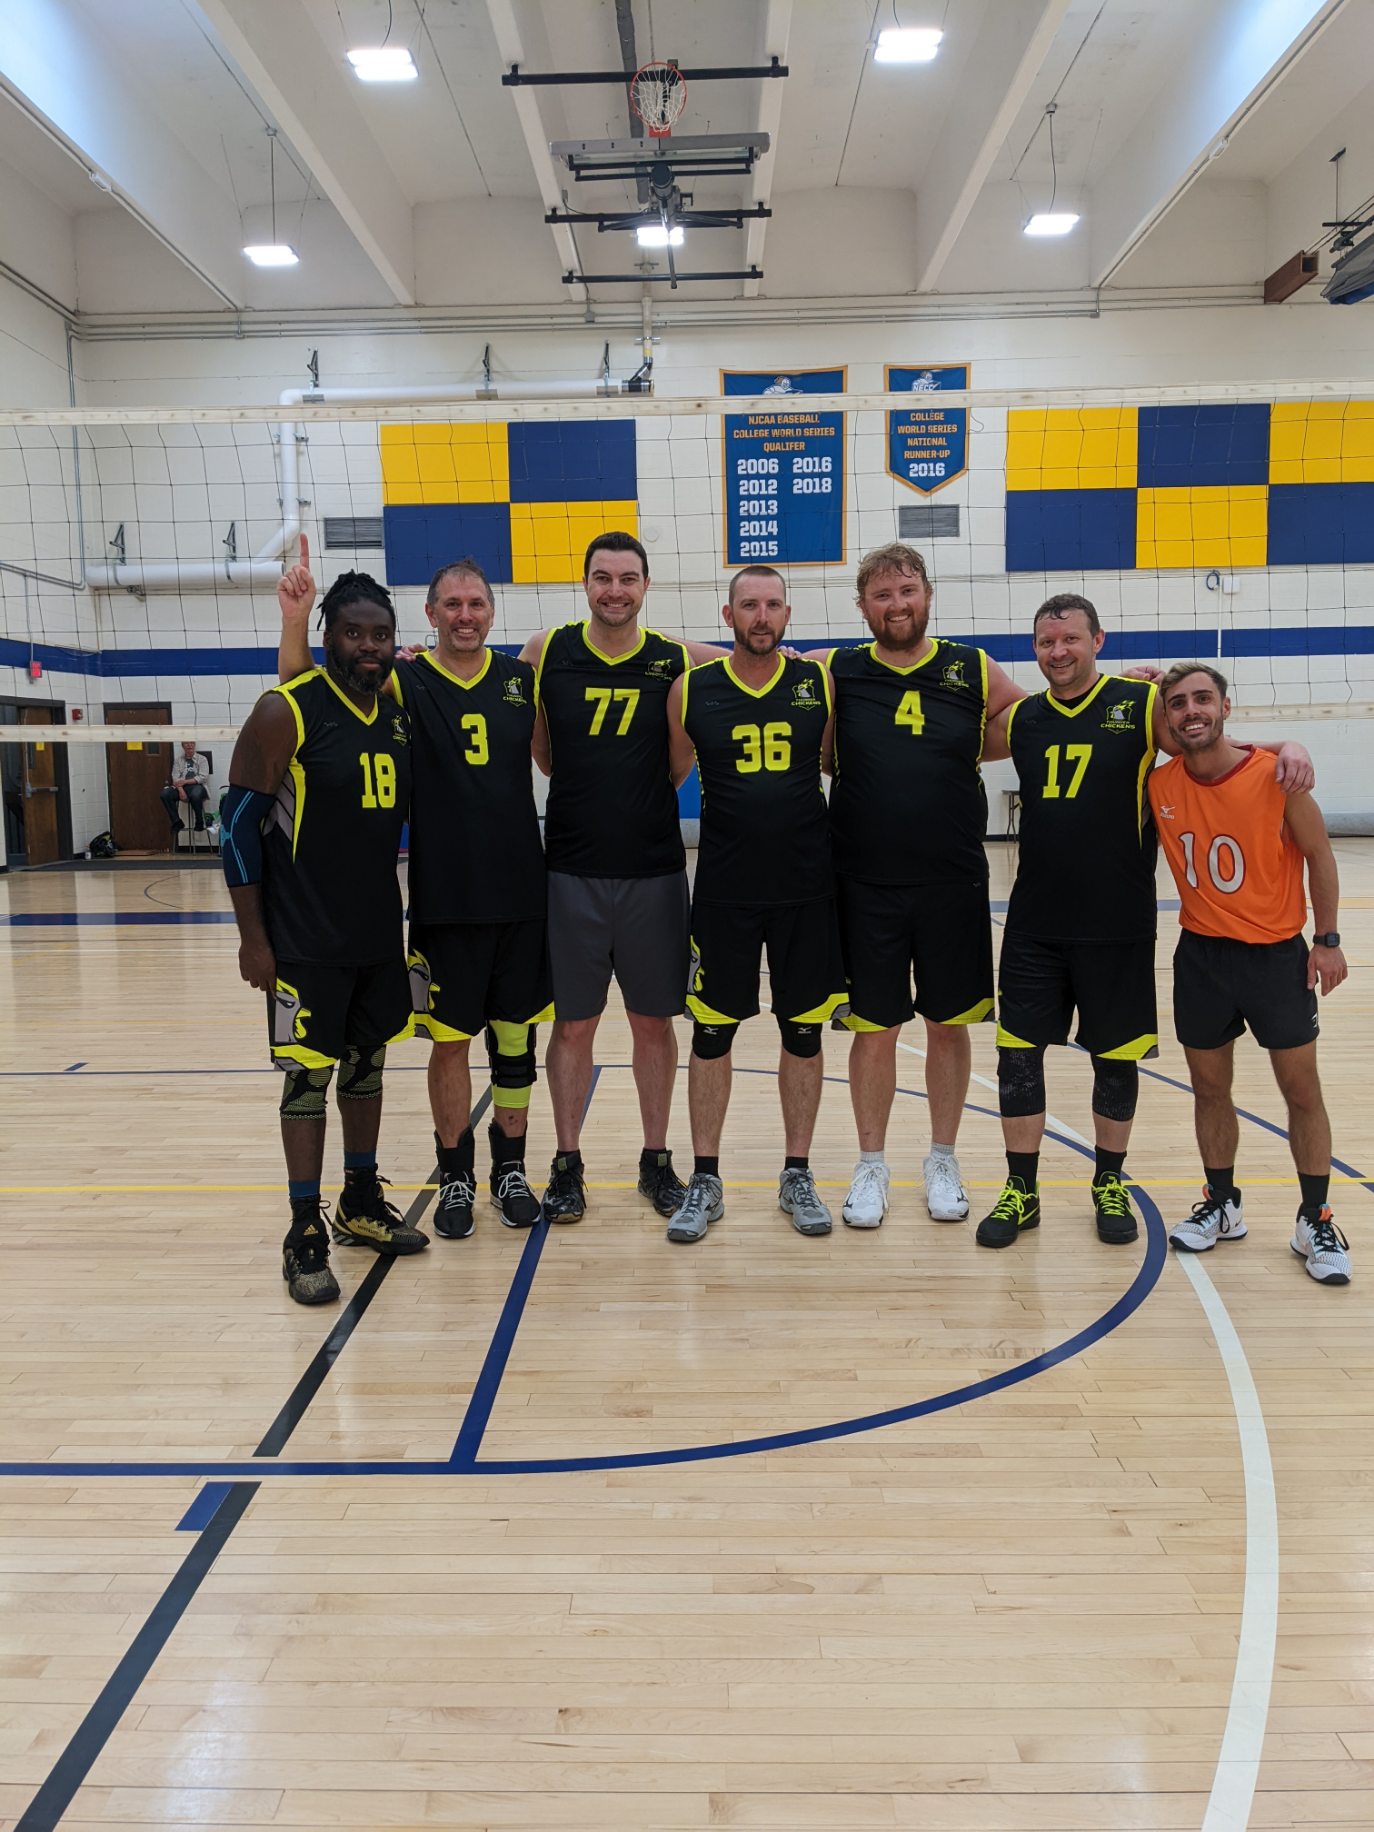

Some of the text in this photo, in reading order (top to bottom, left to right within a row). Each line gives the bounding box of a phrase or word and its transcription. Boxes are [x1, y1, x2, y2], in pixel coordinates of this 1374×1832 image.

[748, 413, 820, 425] NJCAA BASEBALL
[910, 411, 945, 421] COLLEGE
[733, 426, 835, 439] COLLEGE WORLD SERIES
[897, 423, 958, 434] WORLD SERIES
[763, 440, 806, 453] QUALIFER
[907, 437, 948, 447] NATIONAL
[904, 448, 951, 460] RUNNER-UP
[737, 456, 832, 475] 2006 2016
[909, 462, 946, 478] 2016
[739, 477, 832, 496] 2012 2018
[739, 500, 778, 516] 2013
[739, 520, 779, 537] 2014
[740, 540, 778, 557] 2015
[584, 687, 641, 736] 77
[894, 690, 925, 735] 4
[461, 713, 489, 765] 3
[731, 721, 792, 774] 36
[359, 752, 396, 808] 18
[1042, 744, 1093, 799] 17
[1178, 831, 1247, 895] 10
